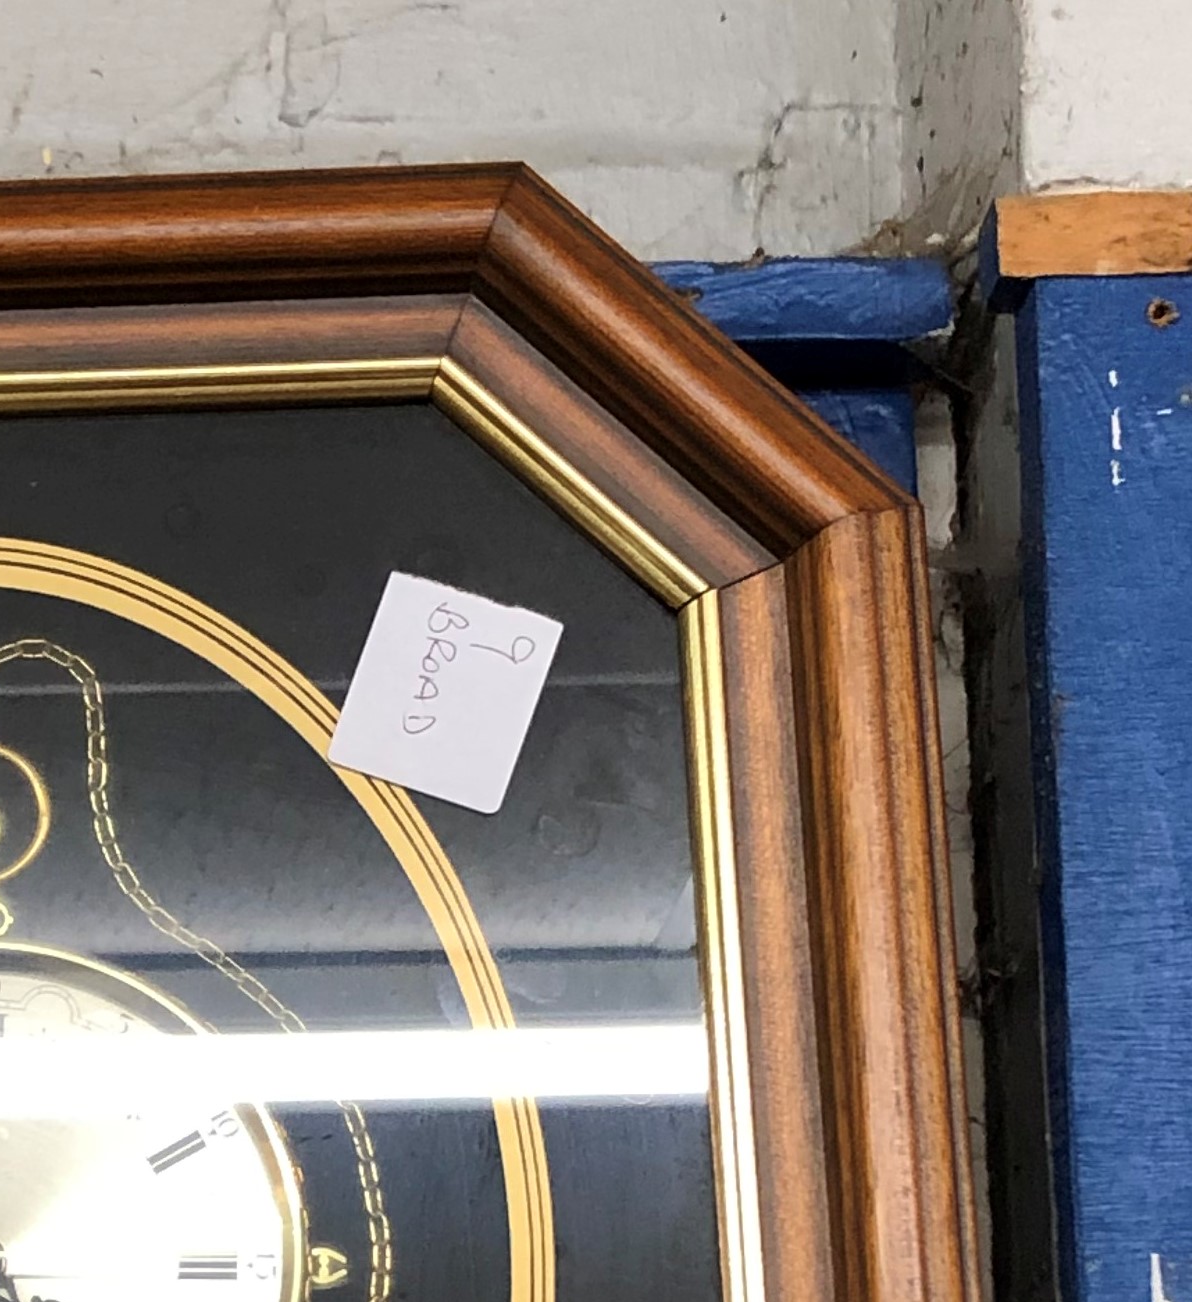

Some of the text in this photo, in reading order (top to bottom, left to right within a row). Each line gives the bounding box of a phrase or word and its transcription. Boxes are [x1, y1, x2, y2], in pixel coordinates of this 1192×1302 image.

[402, 602, 469, 735] BROAD
[210, 1110, 240, 1138] 10
[146, 1130, 206, 1175] II
[176, 1254, 238, 1280] III
